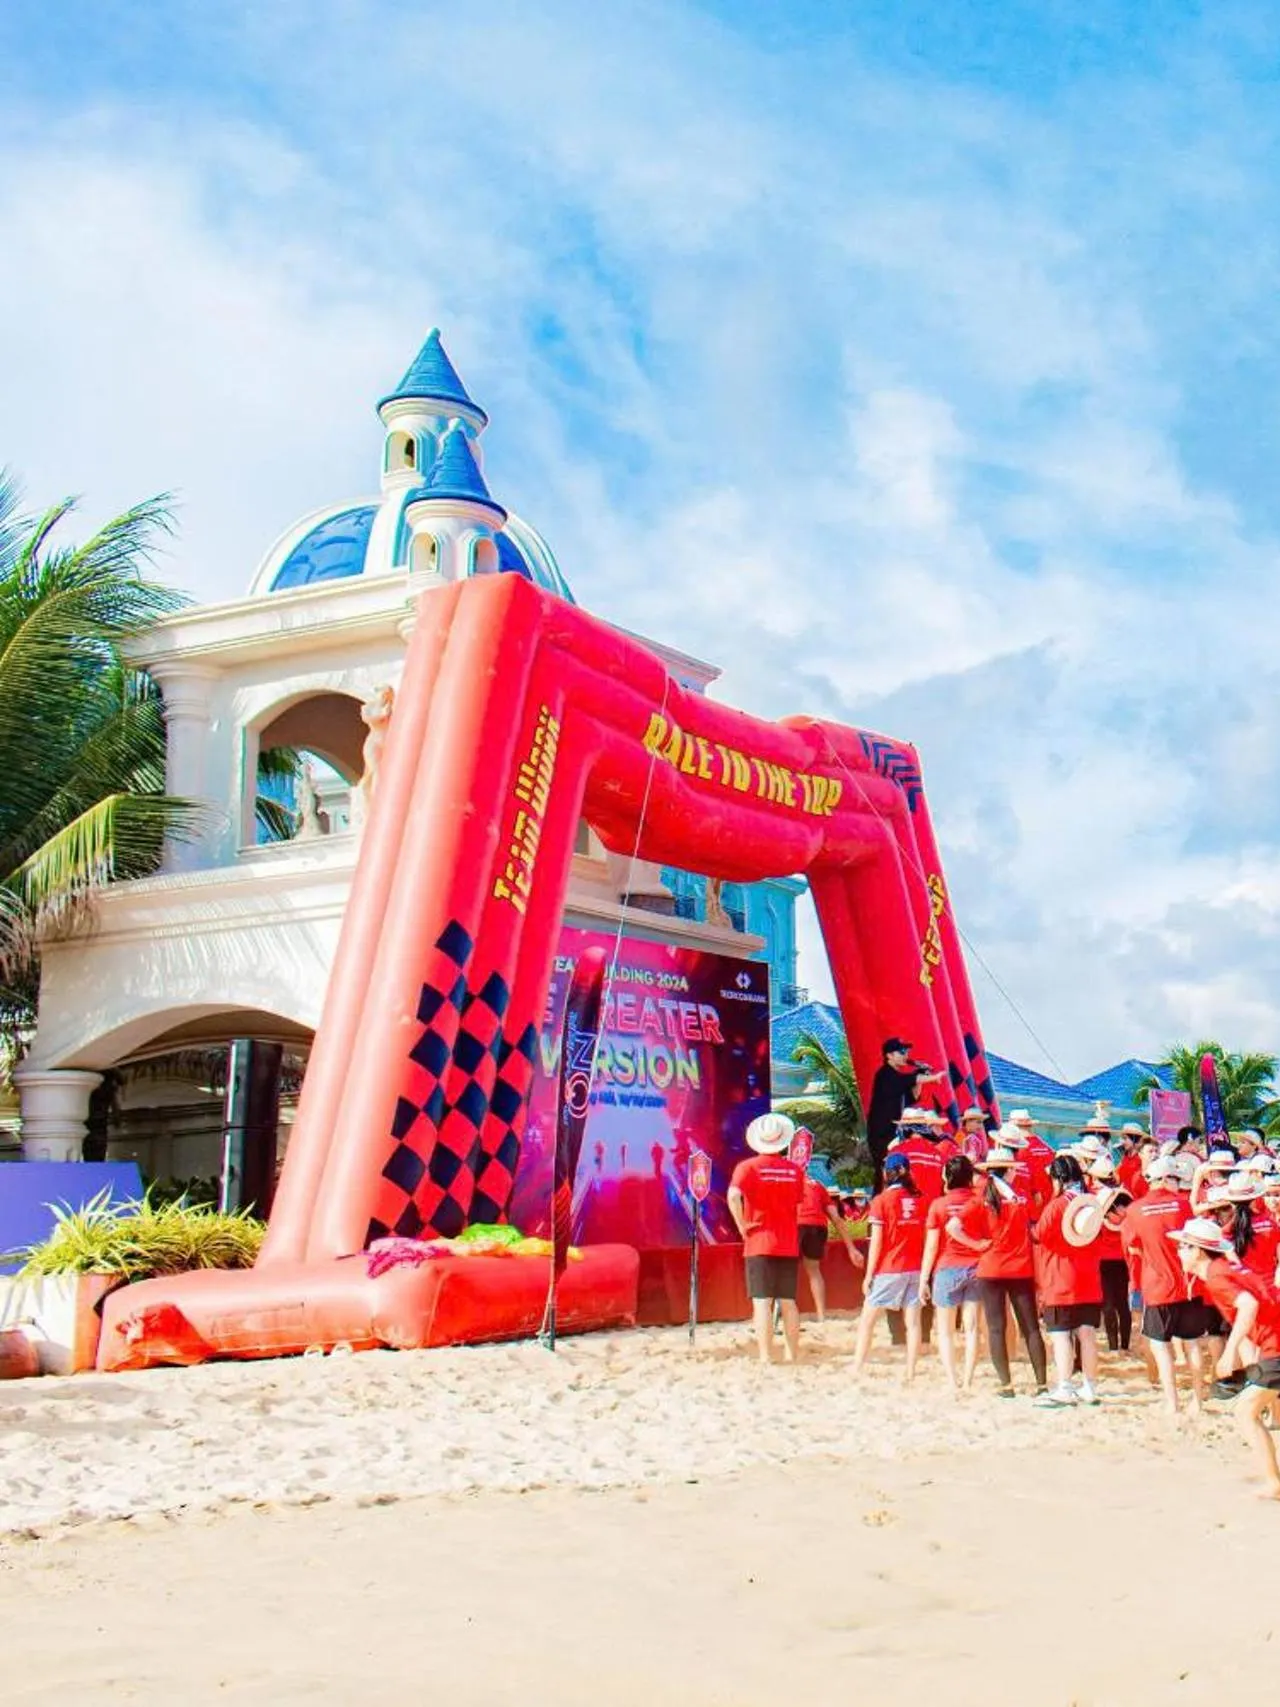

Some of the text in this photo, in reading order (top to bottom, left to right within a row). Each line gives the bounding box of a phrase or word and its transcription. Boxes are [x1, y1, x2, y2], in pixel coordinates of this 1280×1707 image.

[714, 743, 751, 792] TO
[750, 756, 797, 808] THE
[797, 771, 844, 817] TOP
[656, 971, 691, 993] 2024
[541, 1033, 700, 1090] VRSION
